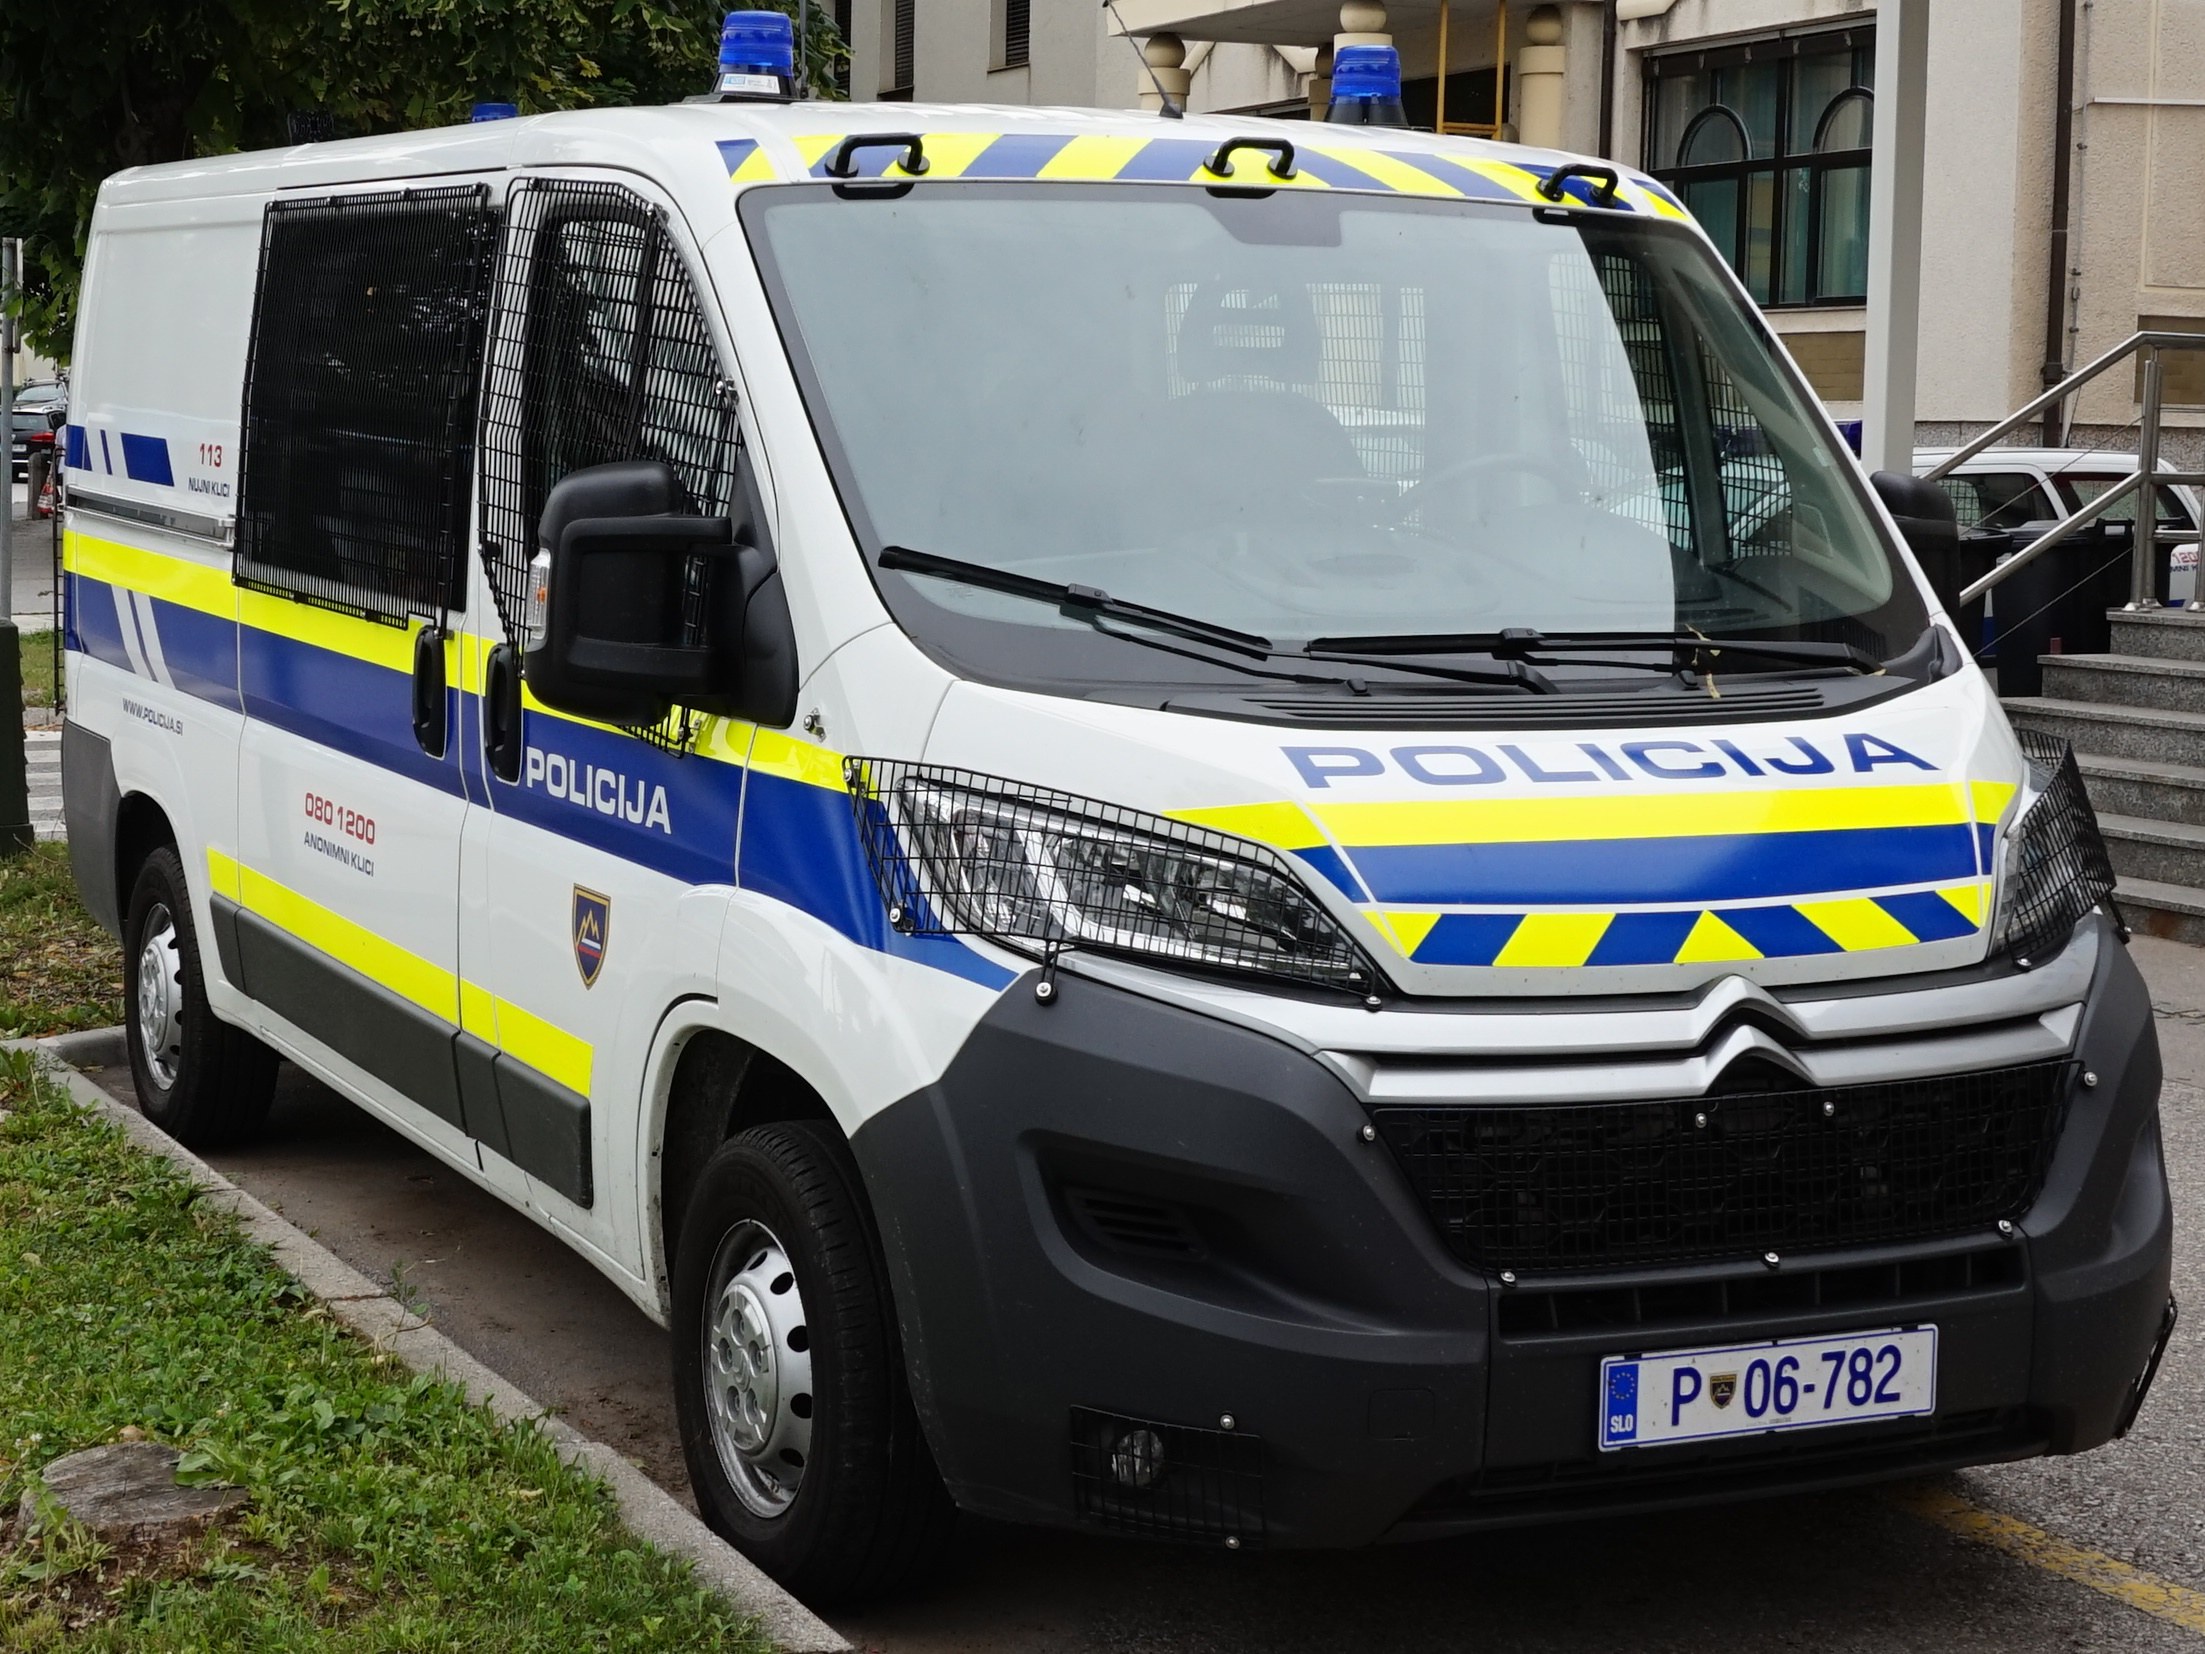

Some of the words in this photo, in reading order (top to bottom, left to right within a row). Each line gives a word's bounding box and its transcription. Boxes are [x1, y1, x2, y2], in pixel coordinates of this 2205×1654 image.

[200, 443, 222, 467] 113
[188, 477, 211, 494] NUJNI
[211, 481, 230, 497] KLICI
[2172, 552, 2198, 564] 120
[122, 698, 184, 736] WWW.POLICIJA.SI
[1278, 732, 1939, 789] POLICIJA
[526, 746, 673, 835] POLICIJA
[305, 792, 333, 826] 080
[337, 806, 375, 845] 1200
[304, 831, 350, 865] ANONIMNI
[351, 851, 375, 877] KLICI
[1671, 1366, 1702, 1427] P
[1743, 1344, 1902, 1418] 06-782
[1610, 1414, 1634, 1434] SLO
